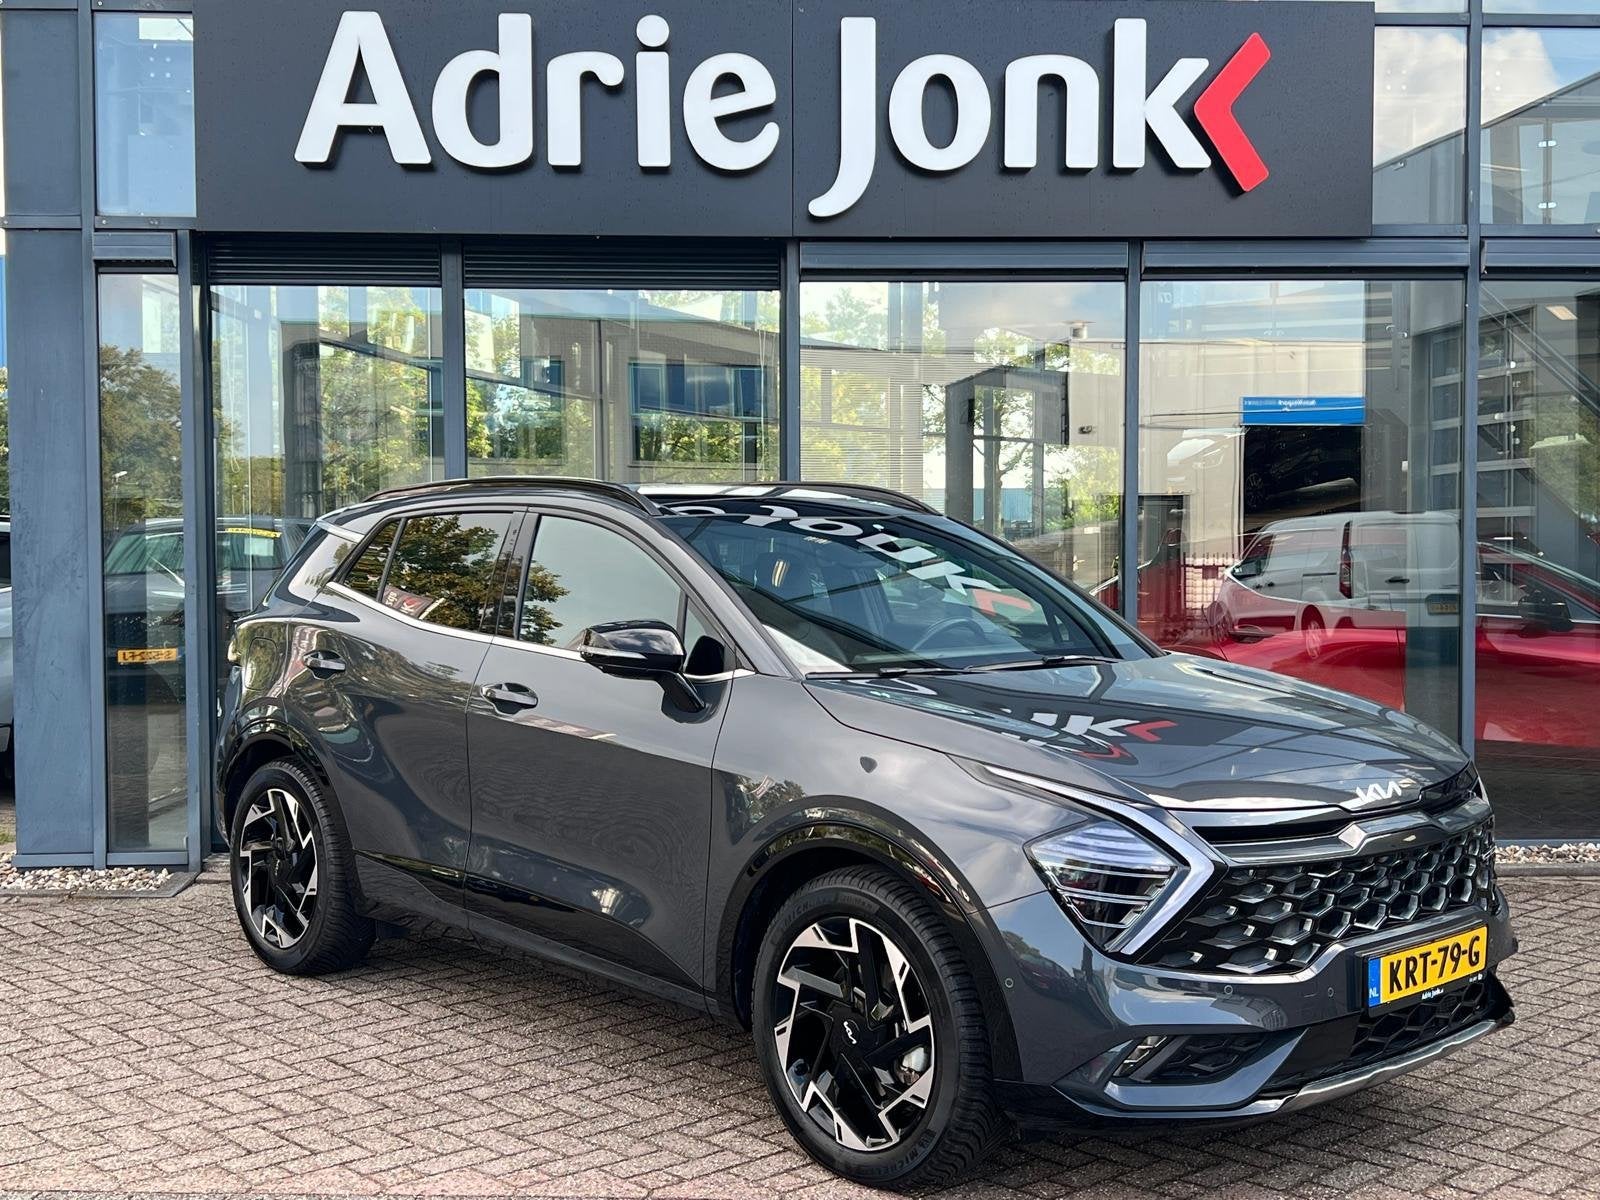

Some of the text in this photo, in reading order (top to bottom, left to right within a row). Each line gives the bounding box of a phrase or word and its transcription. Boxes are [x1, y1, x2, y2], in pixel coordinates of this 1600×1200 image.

[294, 11, 1212, 218] Adrie Jonk
[1355, 780, 1402, 803] KIA
[1389, 935, 1480, 994] KRT-79-G
[1369, 987, 1379, 998] NL
